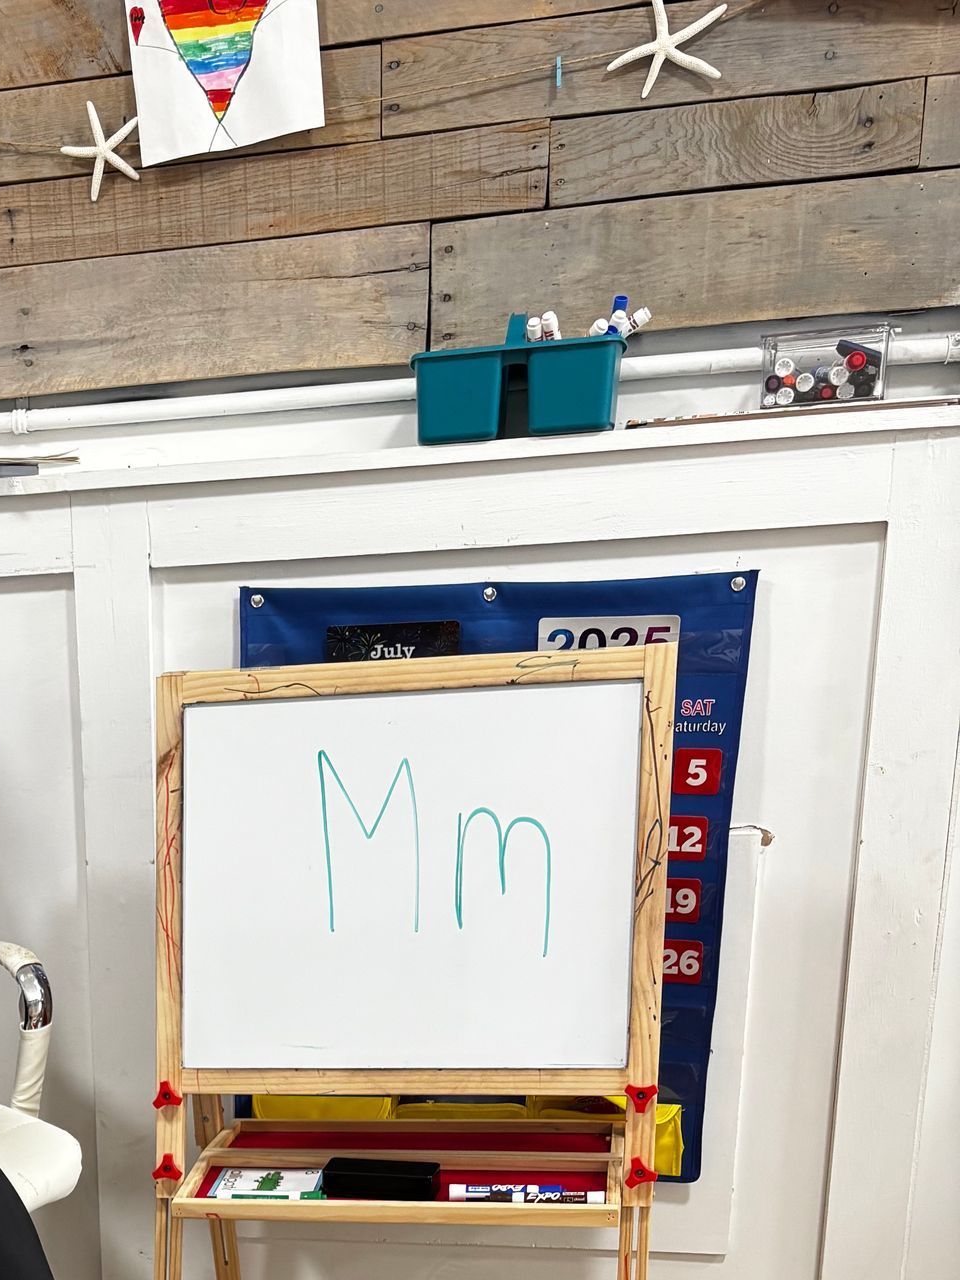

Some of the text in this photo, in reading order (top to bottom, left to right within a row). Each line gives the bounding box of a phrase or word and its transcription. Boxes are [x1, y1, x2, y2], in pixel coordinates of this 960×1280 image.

[371, 642, 416, 660] July
[681, 699, 716, 716] SAT
[675, 720, 726, 735] aturday
[685, 758, 708, 786] 5
[667, 826, 702, 852] 12
[666, 887, 697, 914] 19
[662, 948, 700, 975] 26
[527, 1192, 561, 1203] EXPO
